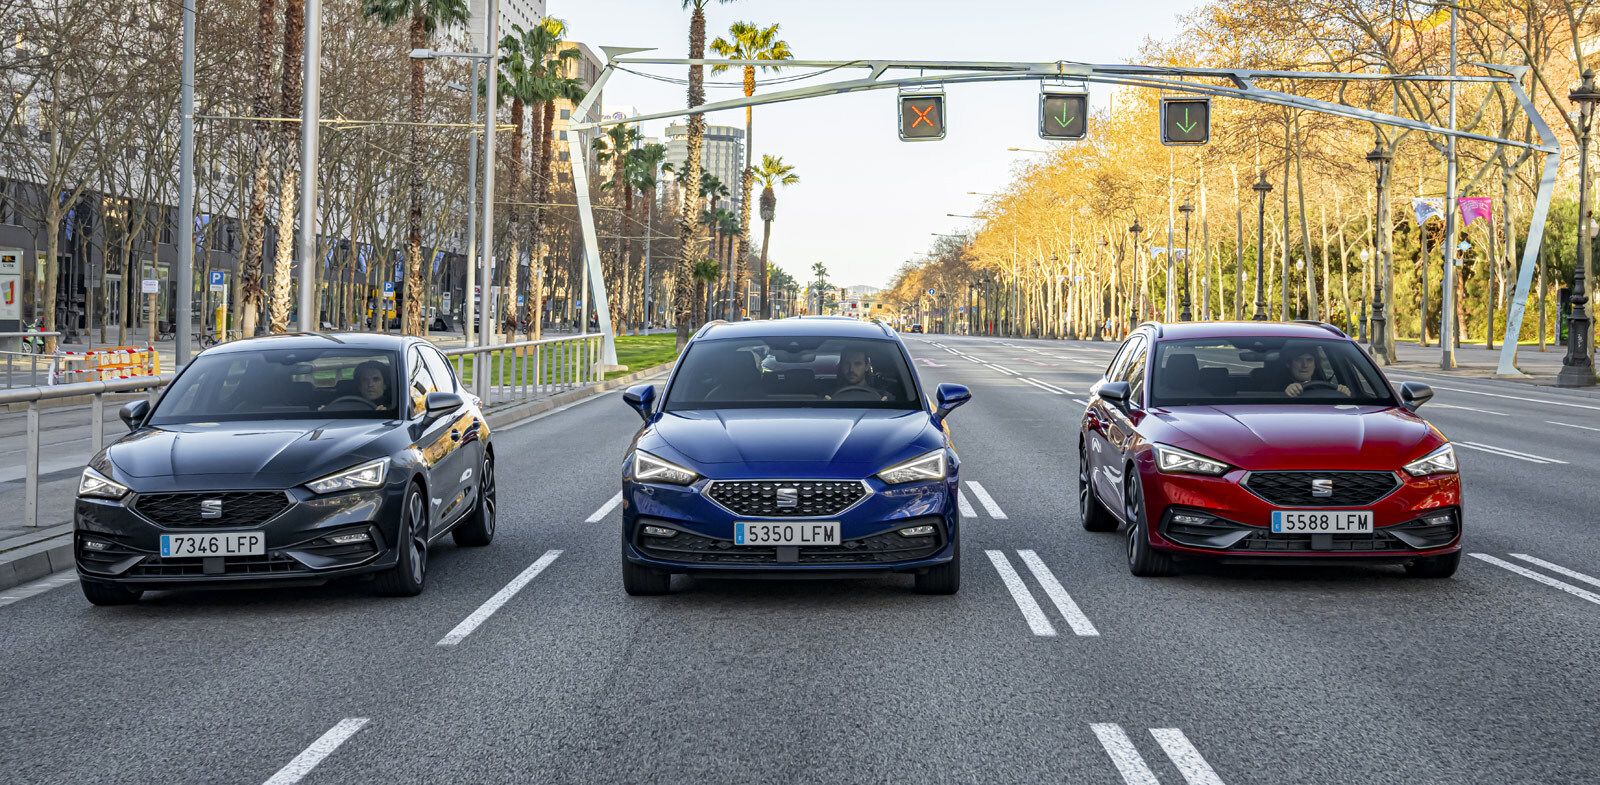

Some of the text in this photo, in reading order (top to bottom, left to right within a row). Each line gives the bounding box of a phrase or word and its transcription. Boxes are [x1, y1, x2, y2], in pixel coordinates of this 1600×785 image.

[212, 272, 221, 284] P
[1286, 514, 1368, 530] 5588 LFM
[749, 525, 834, 542] 5350 LFM
[174, 536, 259, 554] 7346 LFP
